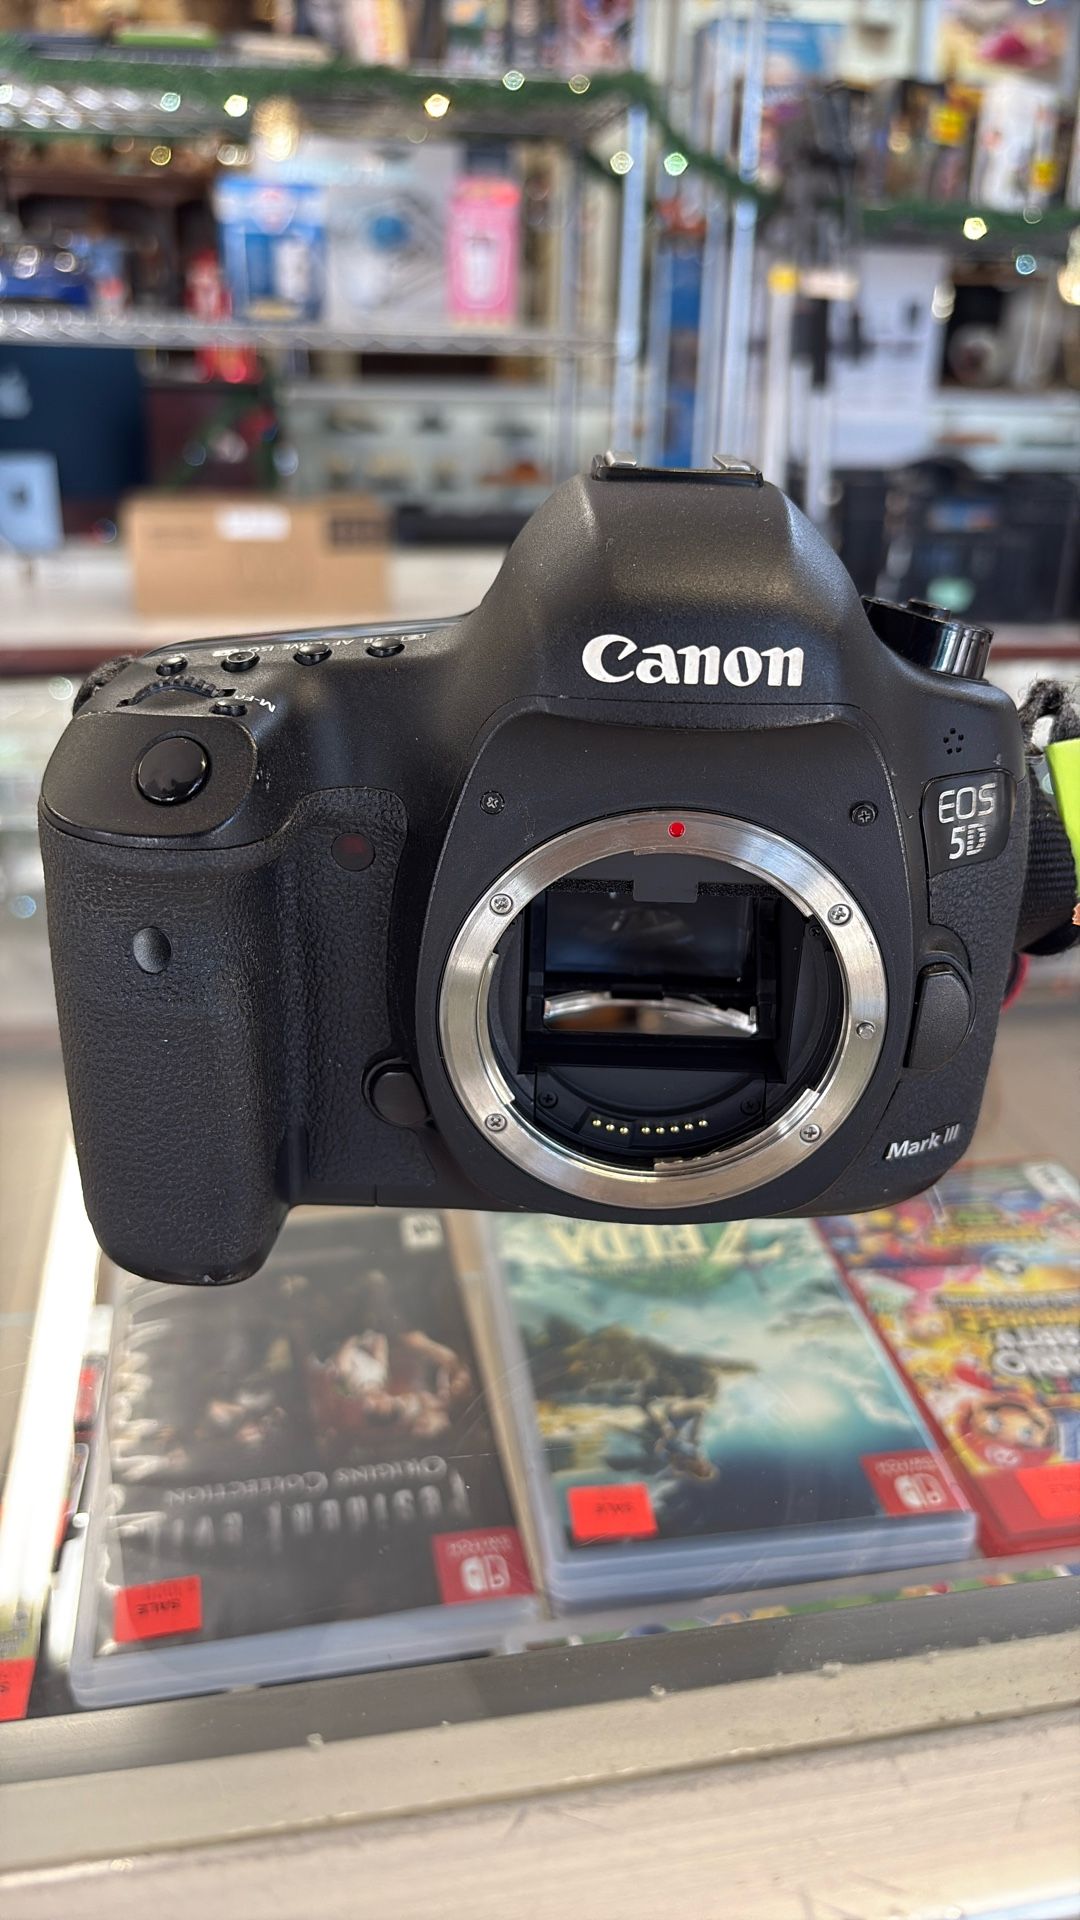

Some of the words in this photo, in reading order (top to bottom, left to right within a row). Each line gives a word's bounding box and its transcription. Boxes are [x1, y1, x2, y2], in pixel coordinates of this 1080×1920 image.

[581, 634, 804, 687] Canon
[234, 693, 276, 713] M-Fn
[938, 783, 998, 824] EOS
[949, 823, 987, 860] 5D
[884, 1132, 942, 1160] Mark
[943, 1123, 960, 1144] III
